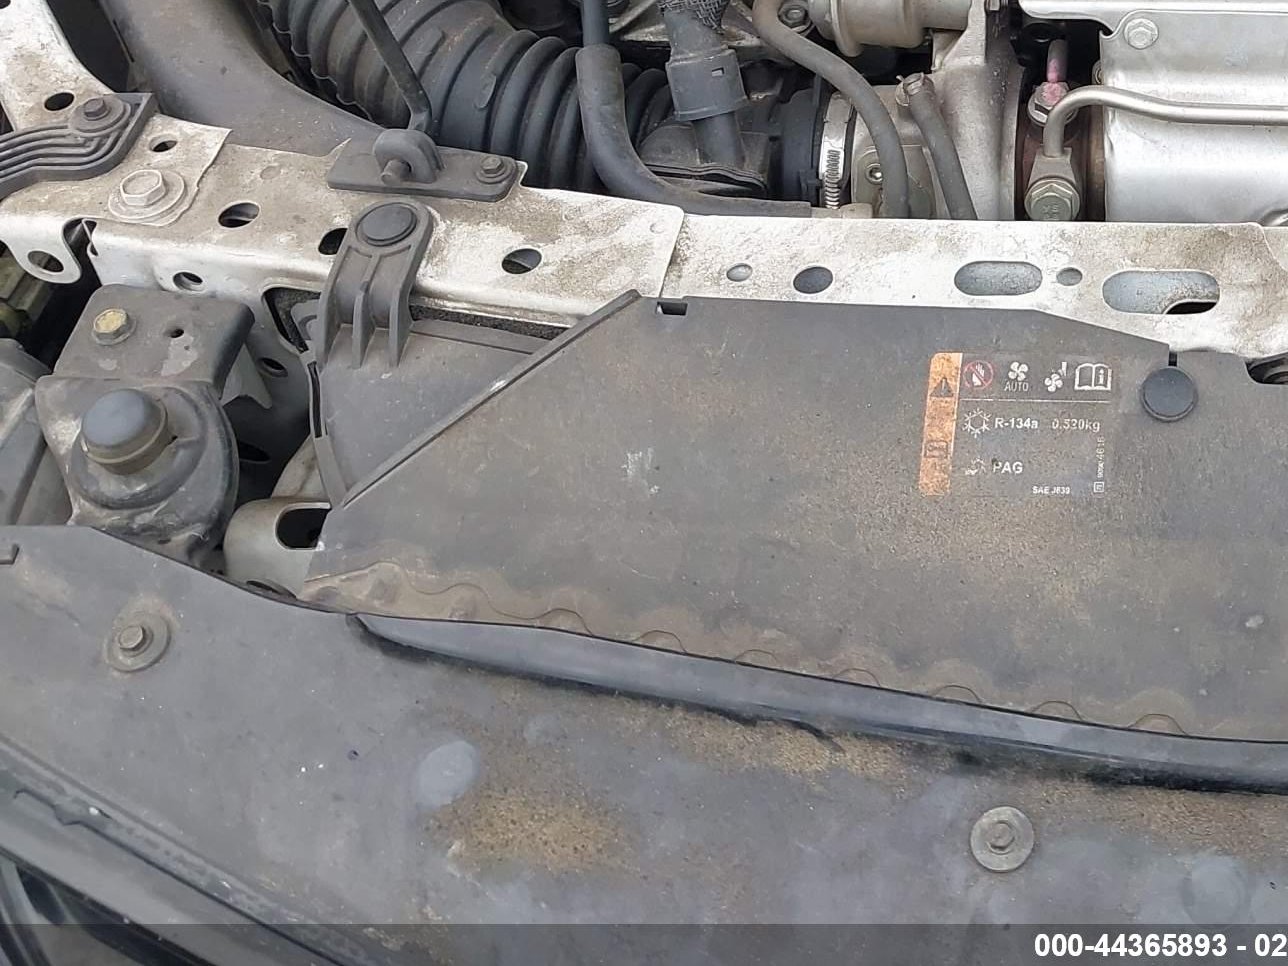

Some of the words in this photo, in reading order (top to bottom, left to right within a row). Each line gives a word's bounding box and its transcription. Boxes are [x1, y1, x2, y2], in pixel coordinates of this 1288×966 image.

[1004, 381, 1029, 392] AUTO
[994, 417, 1039, 429] R-134a
[992, 461, 1023, 474] PAG
[1032, 485, 1050, 494] SAE
